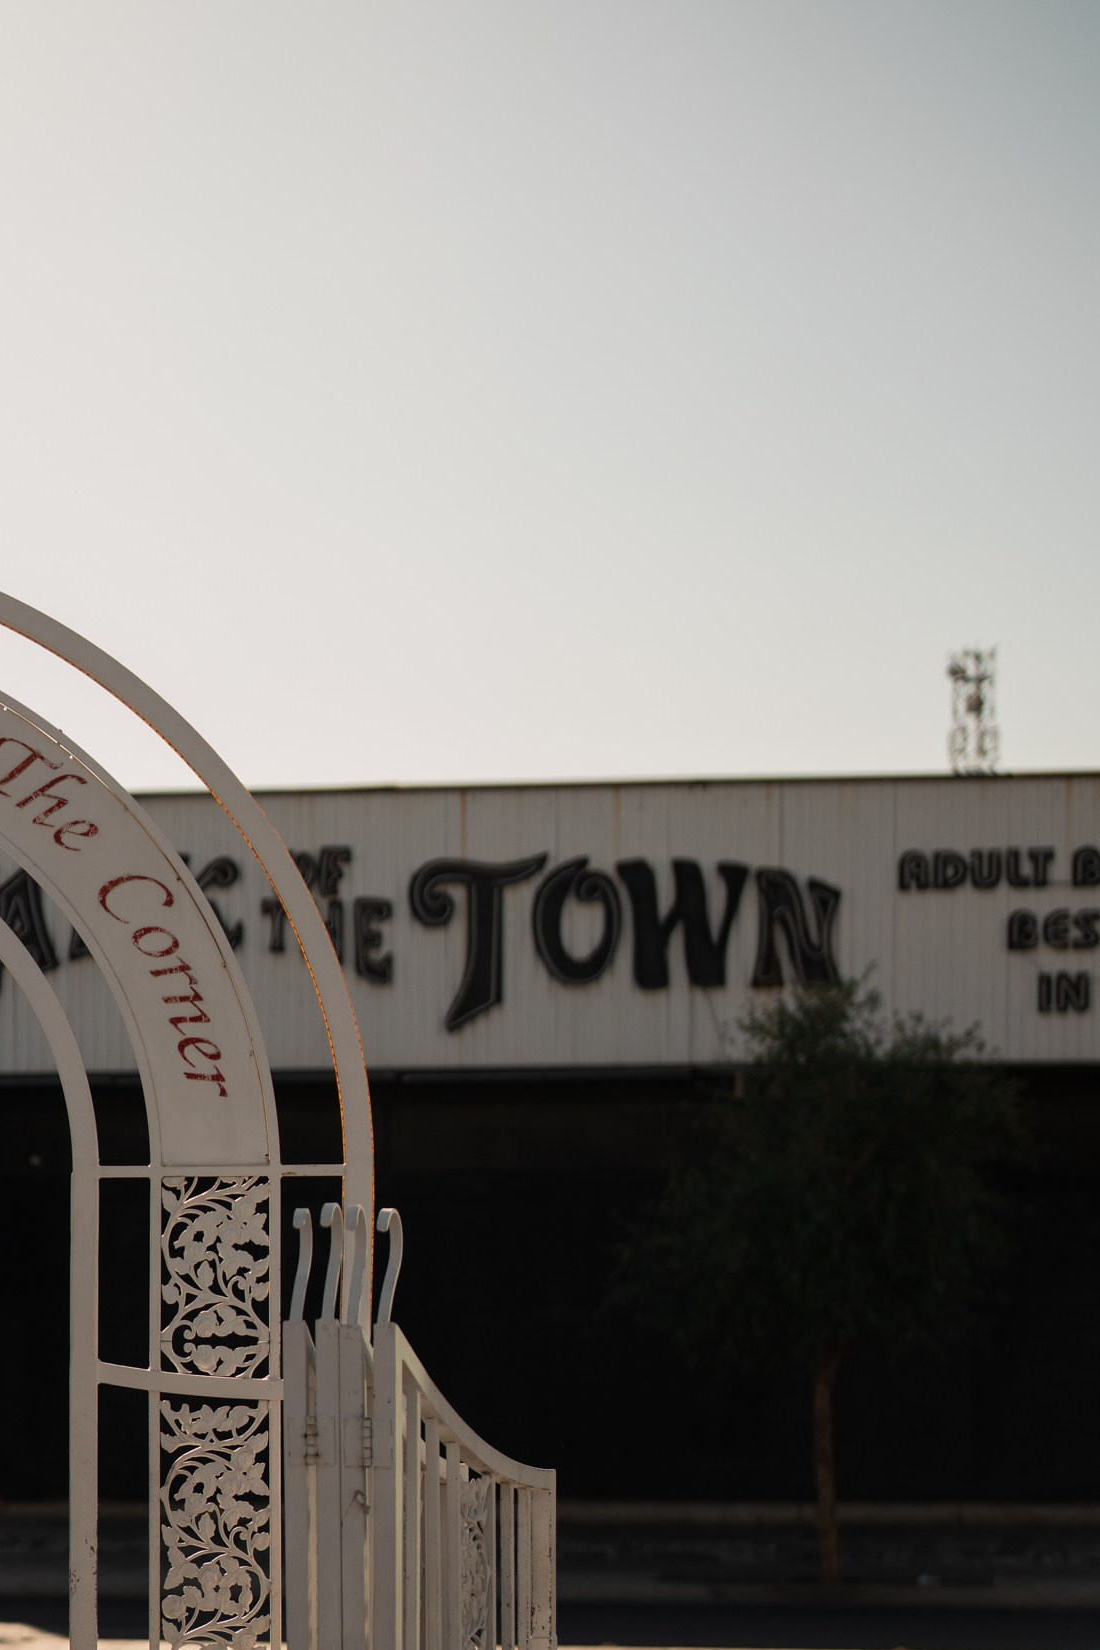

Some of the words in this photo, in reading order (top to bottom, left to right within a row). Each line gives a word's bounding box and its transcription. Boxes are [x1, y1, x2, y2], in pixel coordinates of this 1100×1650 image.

[898, 846, 1055, 891] ADULT
[97, 873, 229, 1099] Corner
[408, 851, 843, 1032] TOWN
[1037, 971, 1090, 1015] IN
